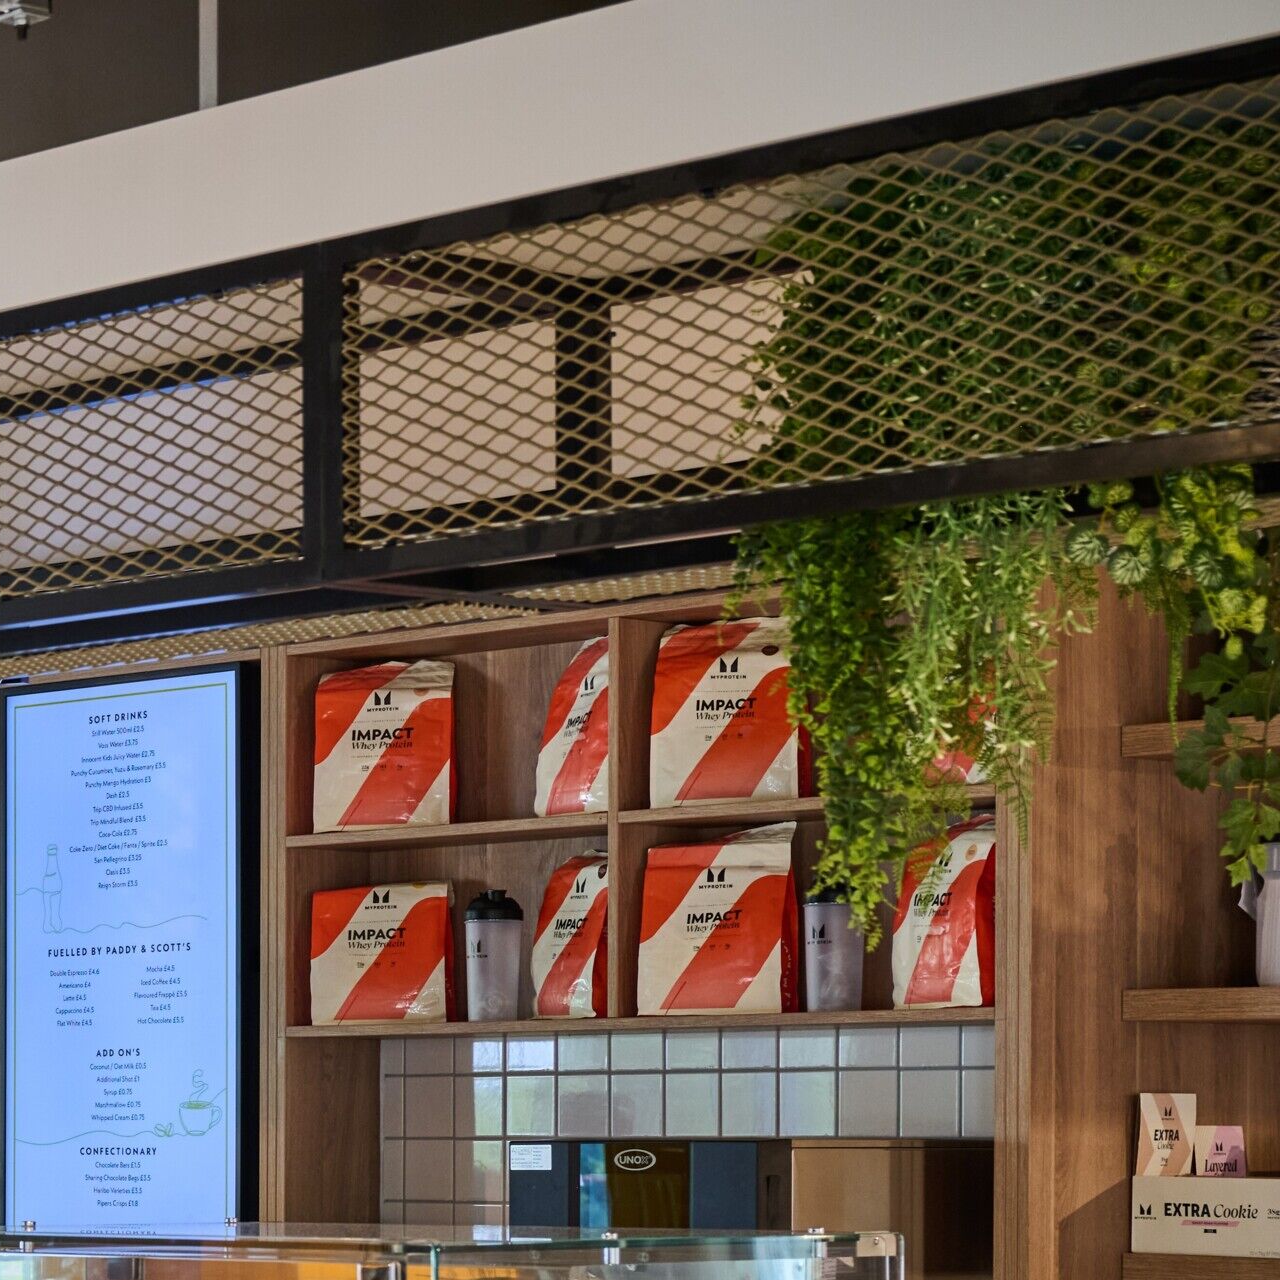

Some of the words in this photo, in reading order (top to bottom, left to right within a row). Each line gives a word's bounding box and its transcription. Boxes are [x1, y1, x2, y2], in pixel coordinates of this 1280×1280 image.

[696, 698, 757, 711] IMPACT
[89, 715, 110, 724] SOFT
[115, 711, 148, 721] DRINKS
[696, 712, 721, 721] Whey
[723, 711, 755, 720] Protein
[352, 728, 414, 741] IMPACT
[352, 742, 377, 750] Whey
[379, 741, 412, 749] Protein
[687, 910, 742, 925] IMPACT
[555, 918, 588, 930] IMPACT
[686, 923, 711, 933] Whey
[347, 928, 406, 941] IMPACT
[48, 948, 87, 957] FUELLED
[91, 947, 101, 955] BY
[106, 945, 136, 955] PADDY
[141, 944, 146, 953] &
[151, 943, 191, 952] SCOTT'S
[348, 941, 372, 949] Whey
[374, 940, 405, 948] Protein
[118, 1048, 140, 1057] ON'S
[1154, 1129, 1179, 1141] EXTRA
[1157, 1142, 1174, 1150] Cookie
[619, 1155, 650, 1165] UNOX
[1205, 1159, 1238, 1173] Layered
[1164, 1203, 1211, 1217] EXTRA
[1214, 1204, 1258, 1219] Cookie
